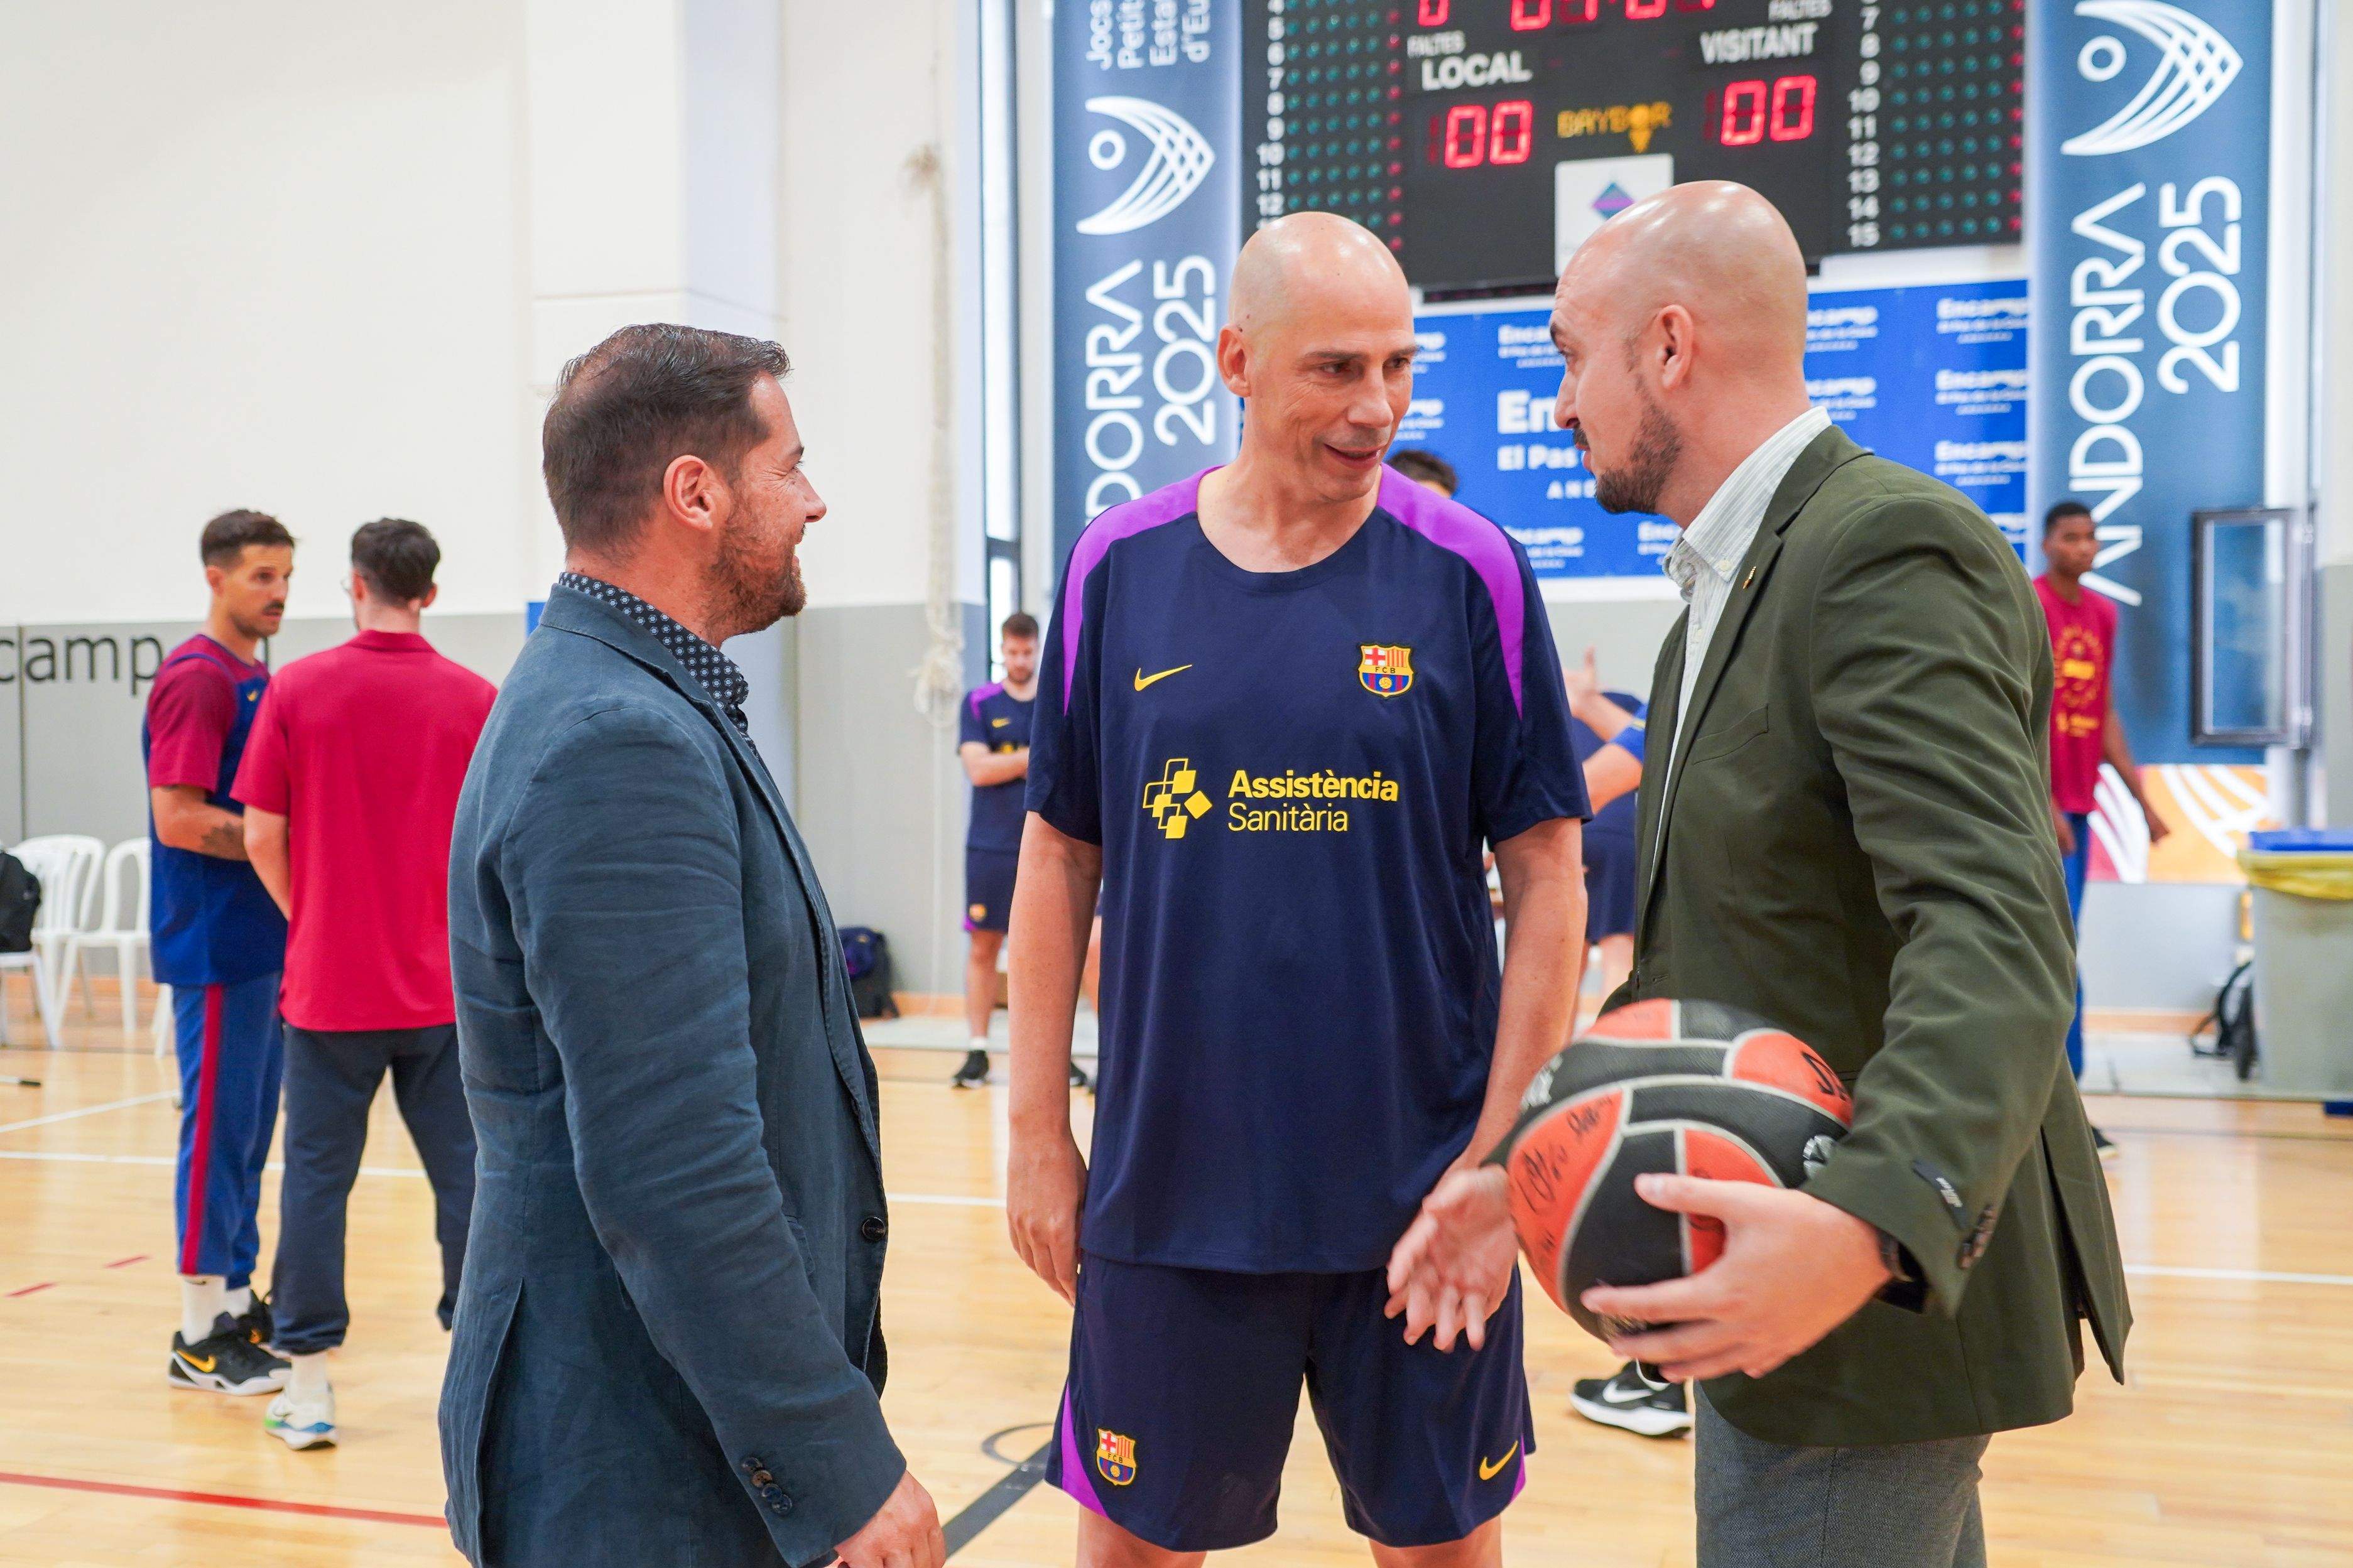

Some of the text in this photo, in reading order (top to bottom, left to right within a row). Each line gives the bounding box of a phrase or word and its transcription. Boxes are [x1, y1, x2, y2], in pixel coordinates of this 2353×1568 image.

[1859, 5, 1880, 31] 7
[1149, 0, 1178, 67] Esta
[1700, 21, 1818, 64] VISITANT
[1268, 67, 1285, 90] 7
[1421, 50, 1533, 91] LOCAL
[1848, 87, 1880, 112] 10
[1848, 114, 1877, 139] 11
[1257, 143, 1285, 166] 10
[1848, 141, 1880, 166] 12
[1257, 167, 1282, 191] 11
[1848, 168, 1880, 193] 13
[1848, 195, 1880, 220] 14
[1848, 222, 1880, 247] 15
[2156, 176, 2242, 394] 2025
[1153, 255, 1216, 446] 2025
[1085, 259, 1143, 526] DORRA
[1528, 445, 1579, 469] Pas
[1227, 769, 1399, 803] Assistència
[1227, 803, 1349, 832] Sanitària
